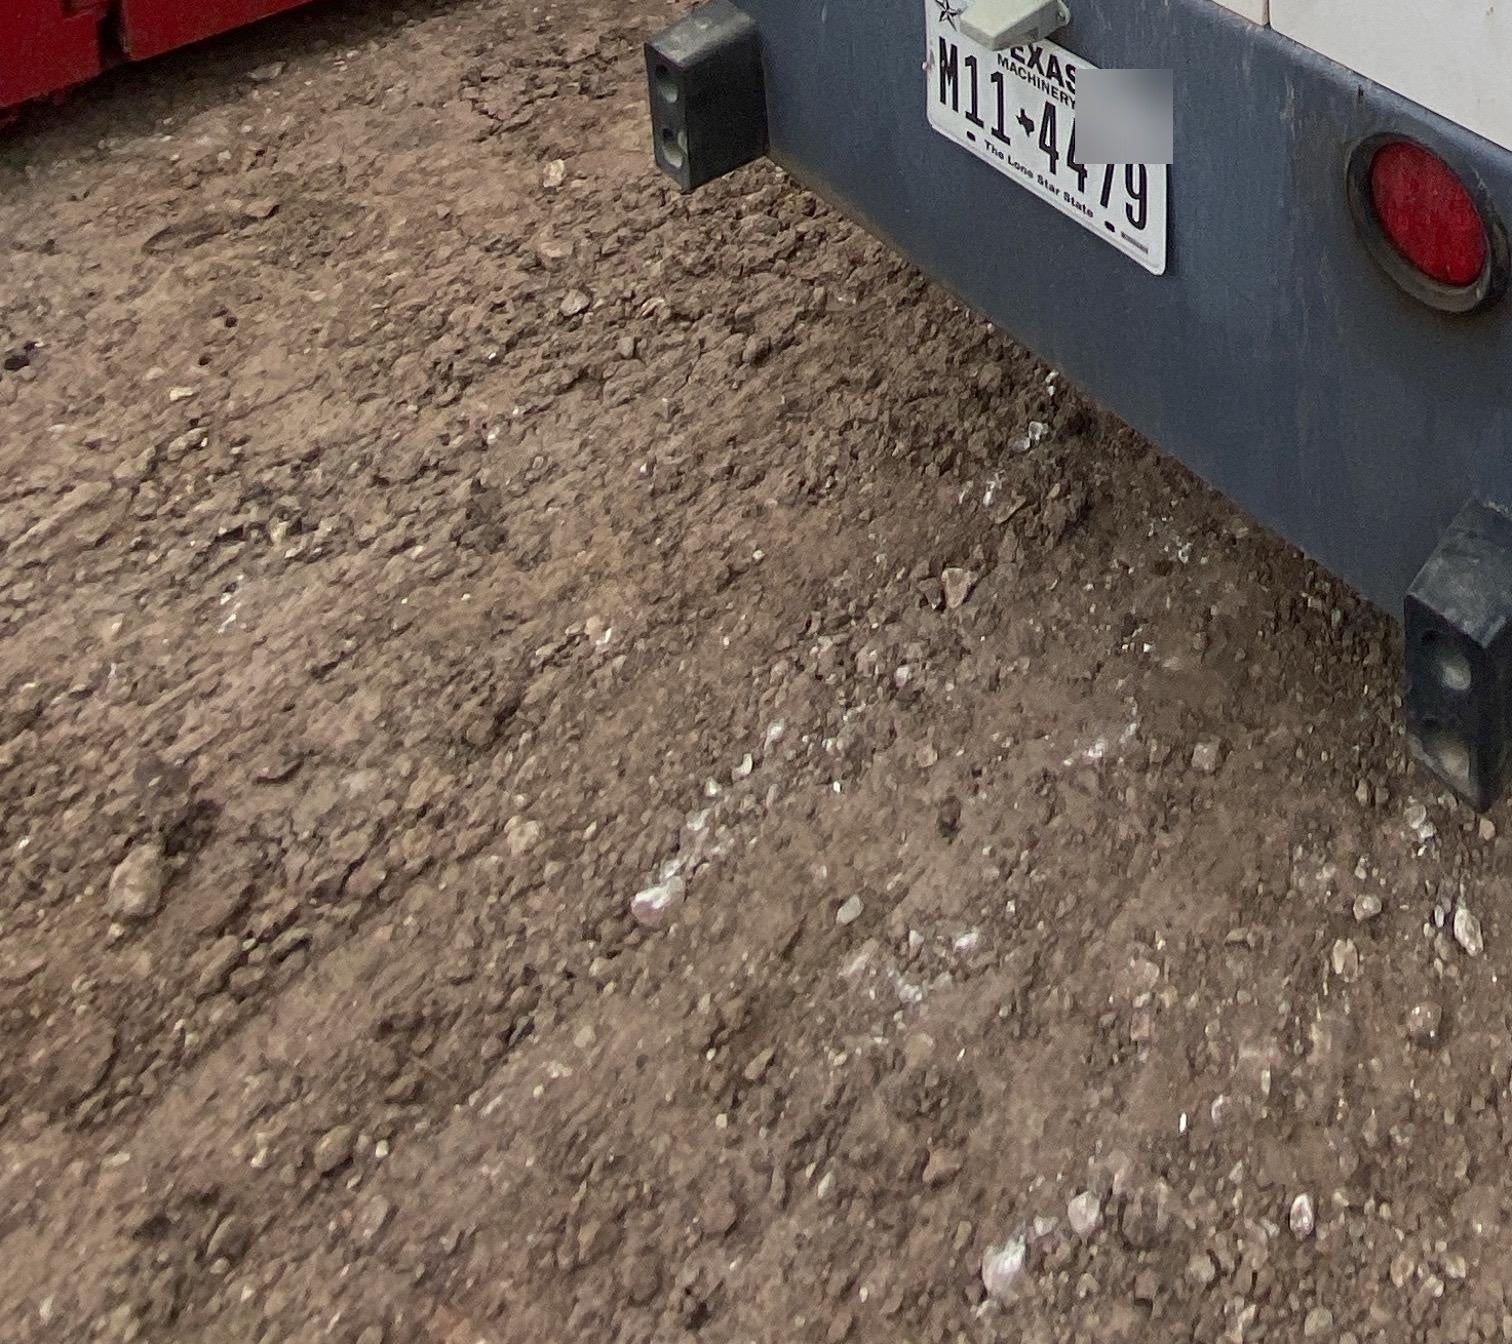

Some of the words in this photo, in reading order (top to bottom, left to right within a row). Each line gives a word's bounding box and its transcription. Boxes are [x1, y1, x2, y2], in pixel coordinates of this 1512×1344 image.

[997, 52, 1077, 111] MACHINERY
[984, 138, 1005, 161] The
[1007, 155, 1034, 179] Lone
[1037, 173, 1061, 196] Star
[1063, 191, 1094, 218] State
